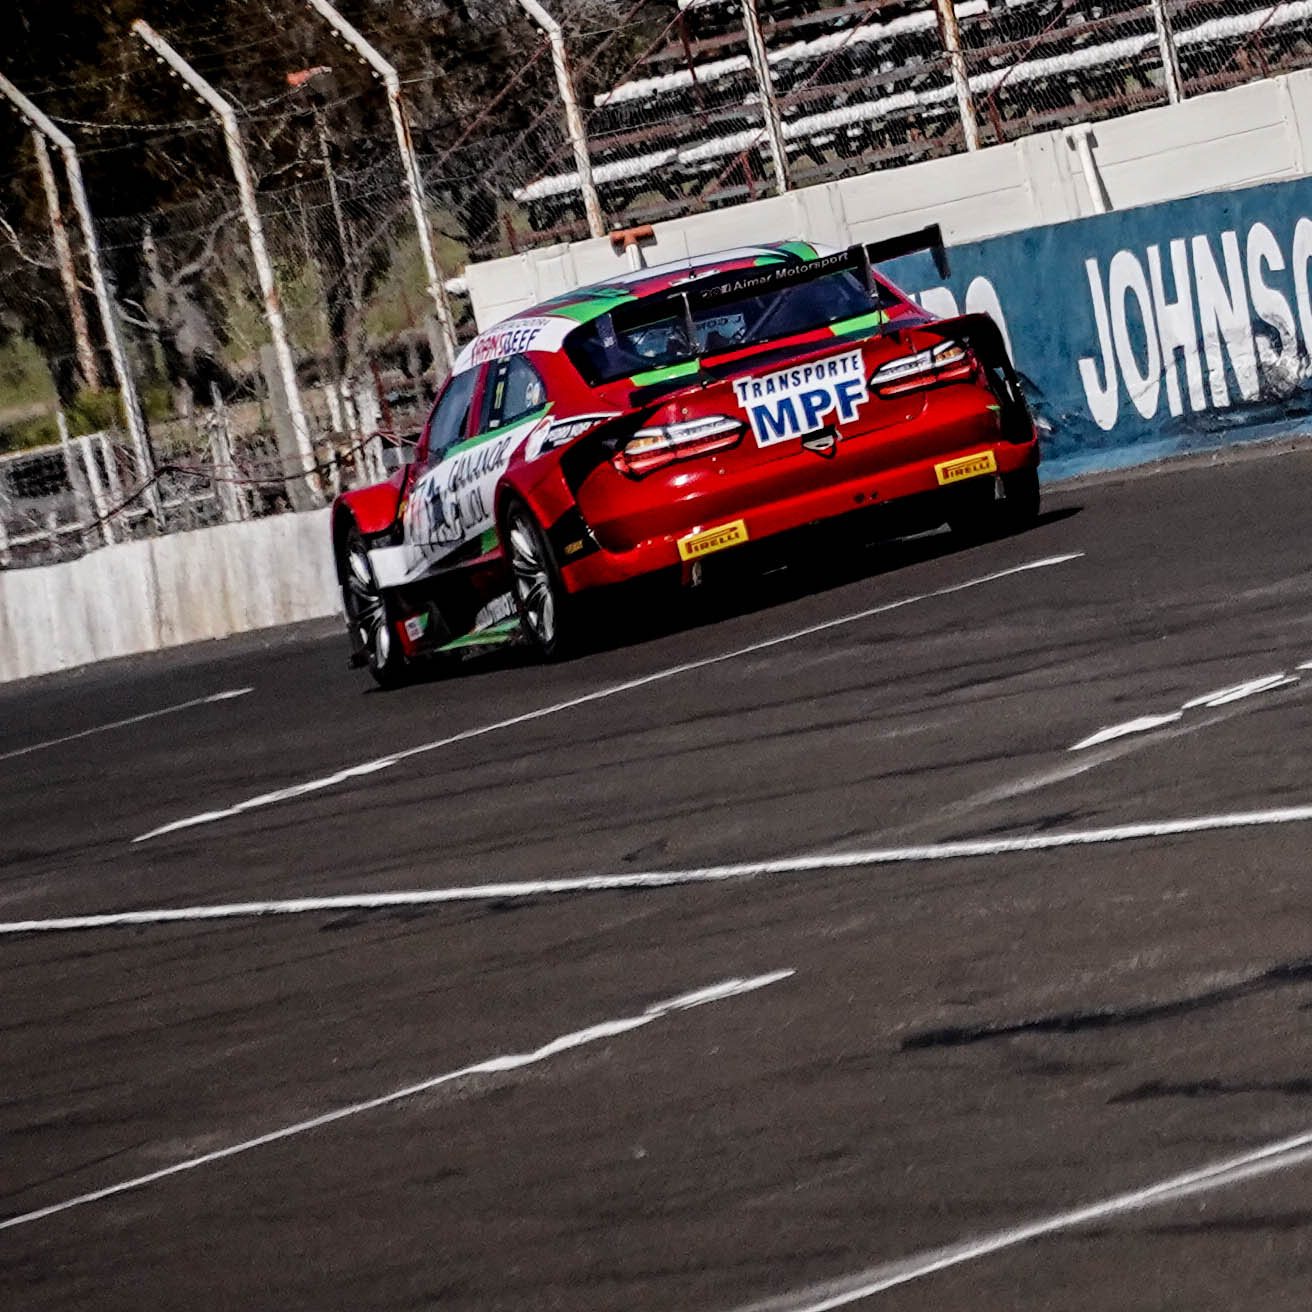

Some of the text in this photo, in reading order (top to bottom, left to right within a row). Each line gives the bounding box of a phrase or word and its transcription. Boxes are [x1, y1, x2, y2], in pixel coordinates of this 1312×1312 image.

[733, 252, 849, 292] Aimar Motorsport
[737, 355, 860, 402] TRANSPORTE
[751, 378, 863, 443] MPF
[942, 455, 991, 481] PIRELLI
[686, 525, 741, 555] PIRELLI
